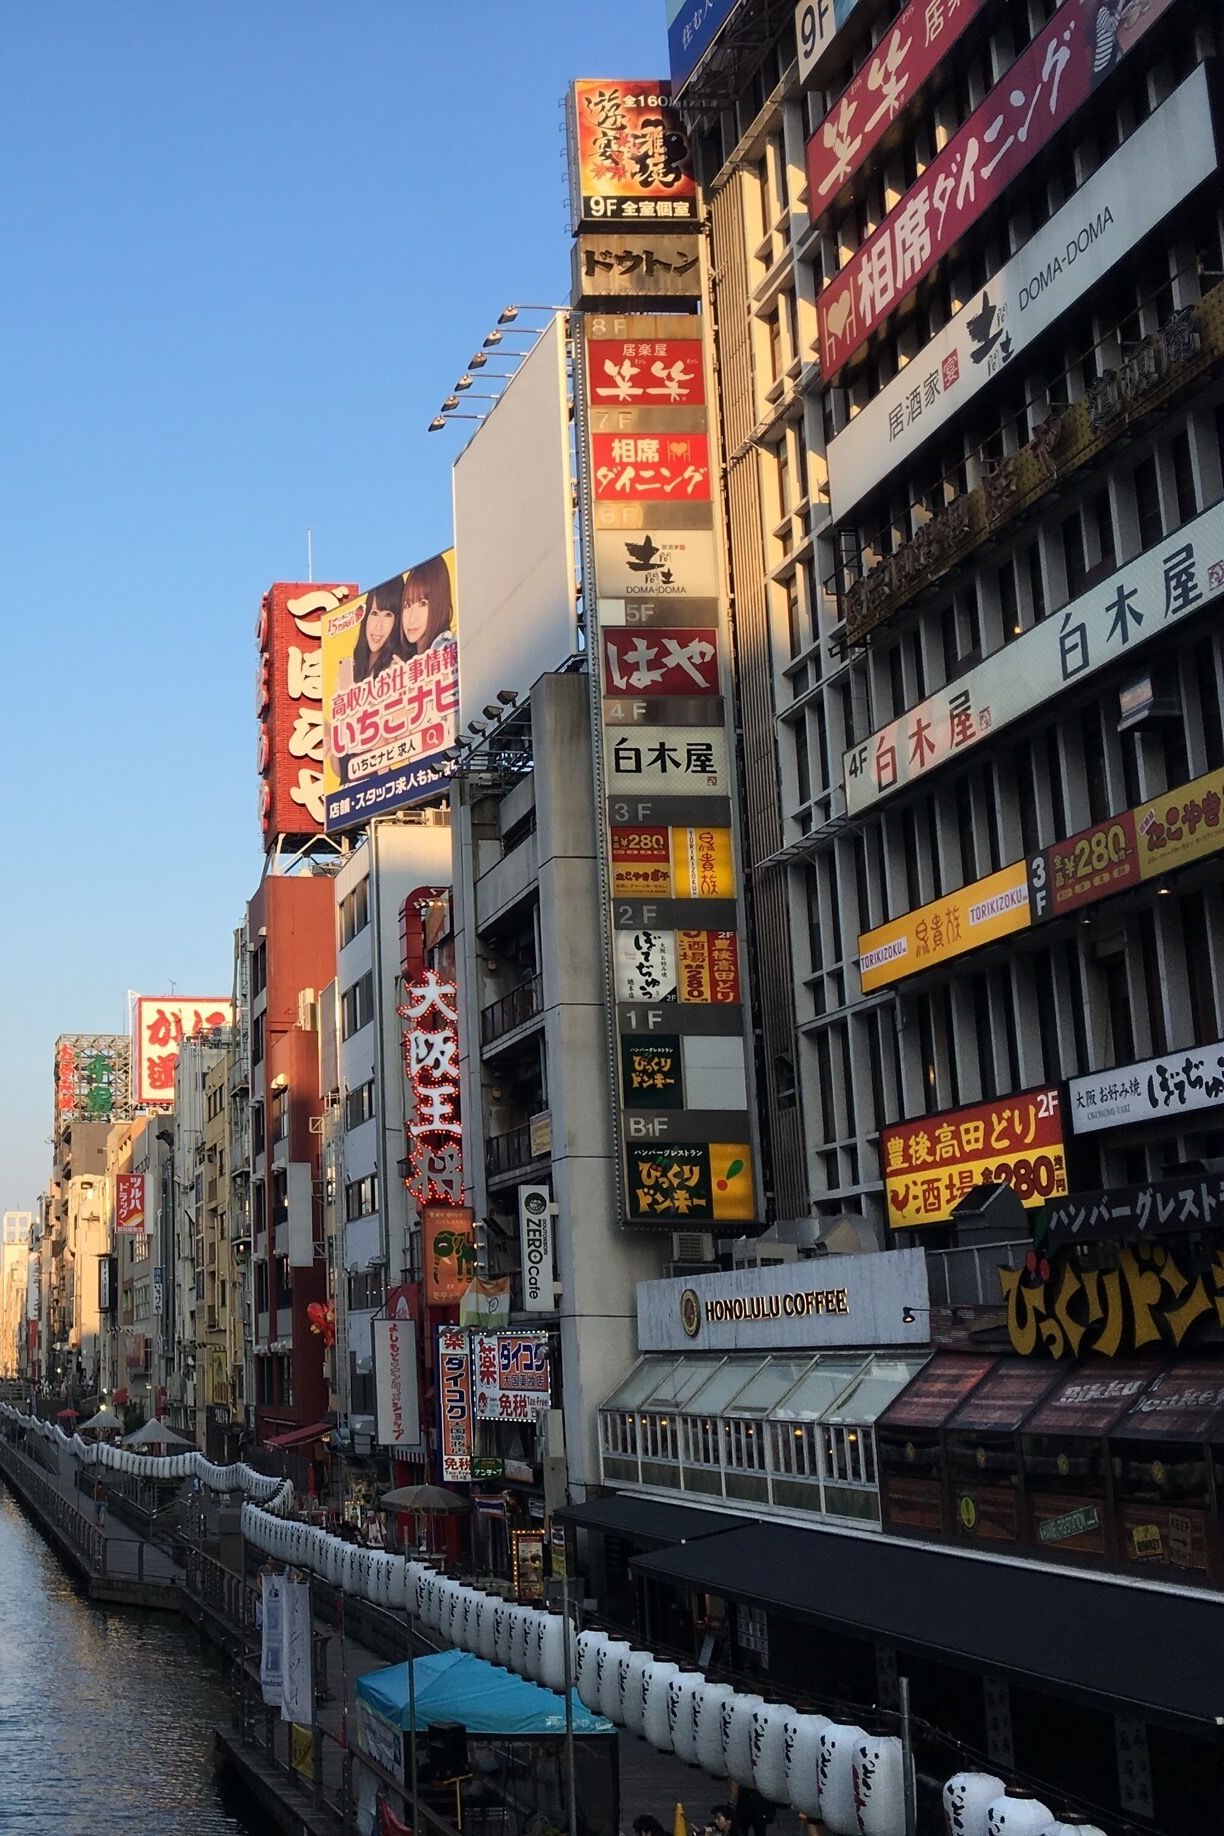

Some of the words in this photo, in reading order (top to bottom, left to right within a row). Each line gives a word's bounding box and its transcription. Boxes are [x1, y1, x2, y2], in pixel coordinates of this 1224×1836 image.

[801, 0, 829, 59] 9F
[624, 95, 676, 108] 全160
[818, 29, 913, 195] 笑笑
[924, 0, 961, 48] 居
[856, 19, 1076, 328] 相席ダイニング
[590, 196, 617, 217] 9F
[621, 201, 691, 217] 全室個室
[584, 249, 699, 276] ドウトン
[1017, 206, 1114, 312] DOMA-DOMA
[622, 343, 668, 357] 居楽屋
[595, 359, 695, 403] 笑笑
[888, 367, 942, 443] 居酒家
[611, 438, 659, 464] 相席
[596, 465, 708, 496] ダイニング
[626, 585, 687, 595] DOMA-DOMA
[626, 604, 655, 622] 5F
[1060, 540, 1204, 682] 白木屋
[607, 637, 716, 690] はや
[332, 642, 458, 721] 高収入お仕事情報
[331, 676, 461, 755] いちごナビ
[610, 702, 646, 719] 4F
[397, 738, 417, 758] 求人
[614, 736, 718, 775] 白木屋
[849, 746, 869, 778] 4F
[875, 688, 978, 794] 白木屋
[614, 803, 652, 822] 3F
[619, 905, 657, 925] 2F
[626, 1011, 663, 1030] 1F
[632, 1054, 672, 1072] びっくり
[399, 970, 465, 1205] 大阪王将
[630, 1072, 675, 1089] ドンキー
[1075, 1088, 1098, 1111] 大阪
[1099, 1076, 1143, 1103] お好み焼
[1147, 1055, 1224, 1109] ぼてぢゅ
[1036, 1091, 1059, 1120] 2F
[629, 1117, 669, 1138] B1F
[886, 1104, 1036, 1173] 豊後高田どり
[637, 1160, 701, 1188] びっくり
[129, 1176, 143, 1211] ツルハ
[636, 1187, 707, 1214] ドンキー
[1049, 1181, 1224, 1233] ハンバーグレスト
[705, 1297, 782, 1322] HONOLULU
[783, 1287, 850, 1317] COFFEE
[478, 1343, 498, 1386] 薬
[500, 1341, 548, 1373] ダイコク
[444, 1354, 466, 1420] ダイコク
[498, 1392, 528, 1419] 免税
